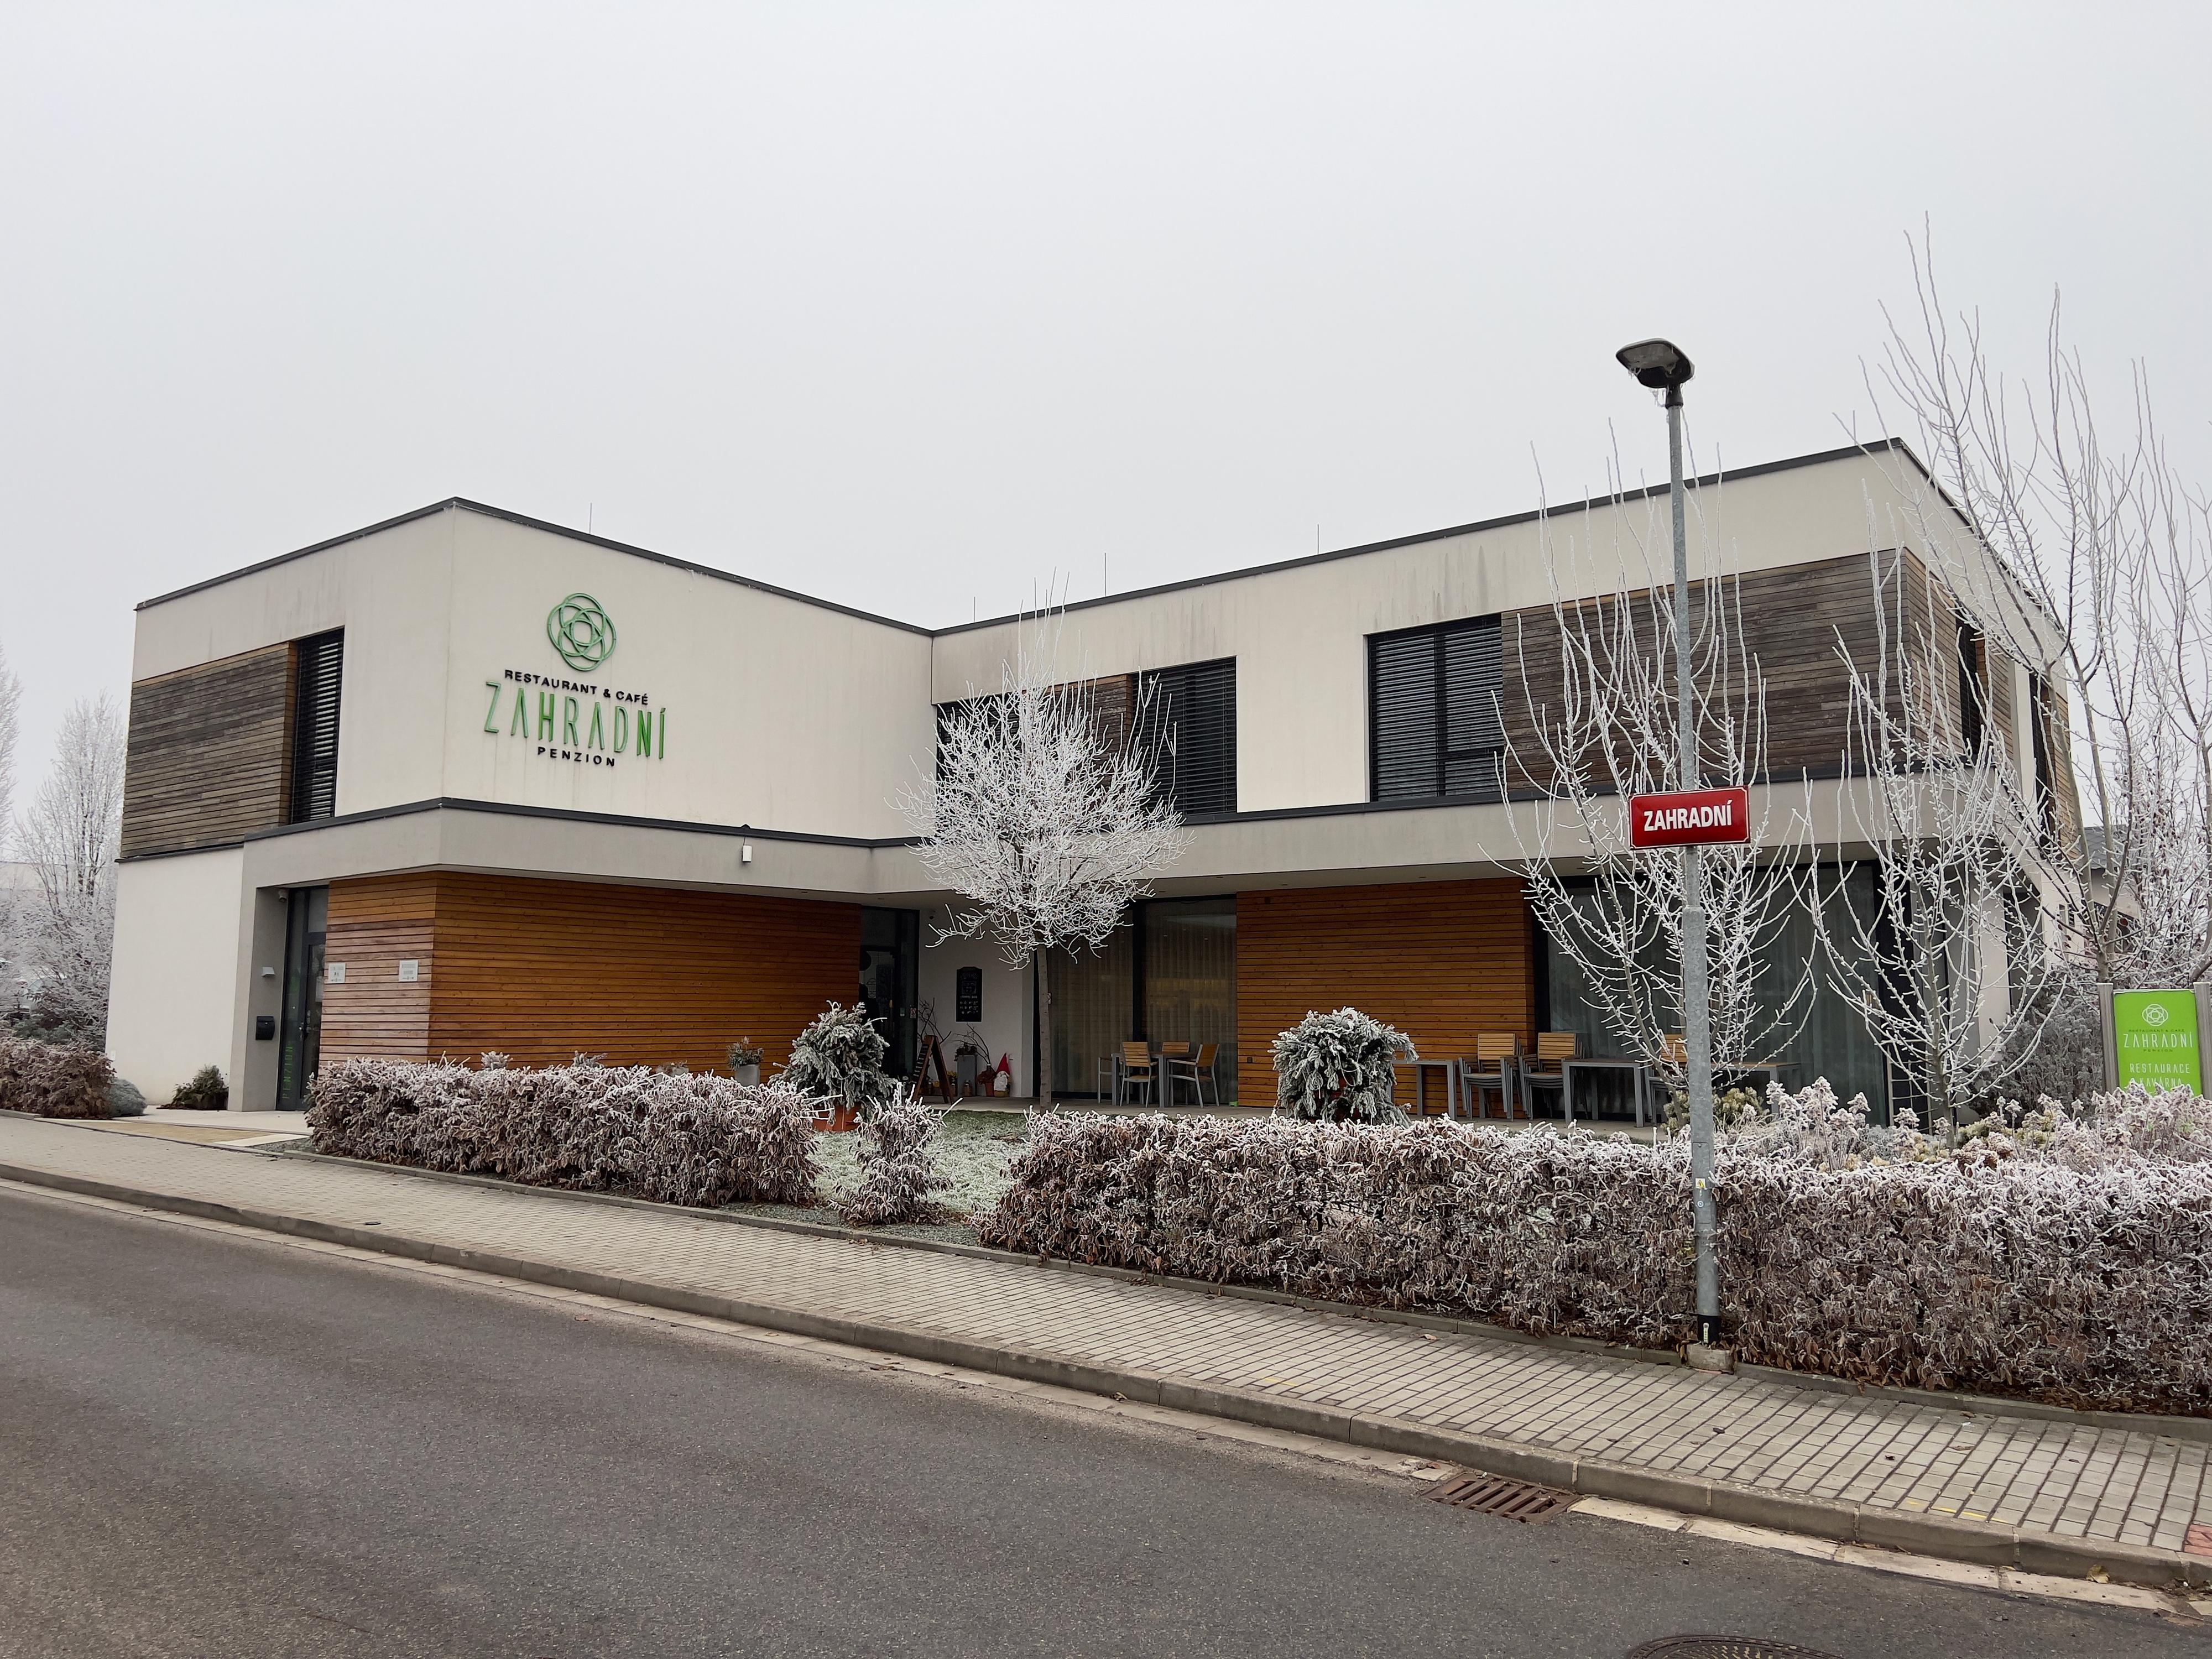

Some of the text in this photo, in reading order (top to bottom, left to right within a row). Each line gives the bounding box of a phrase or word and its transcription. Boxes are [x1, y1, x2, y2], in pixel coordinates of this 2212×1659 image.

[504, 669, 649, 705] RESTAURANT & CAFÉ
[484, 681, 666, 760] ZAHRADNÍ
[538, 747, 615, 767] PENZION
[1644, 800, 1733, 831] ZAHRADNÍ
[2124, 1032, 2192, 1047] ZAHRADNÍ
[2130, 1063, 2190, 1073] RESTAURACE
